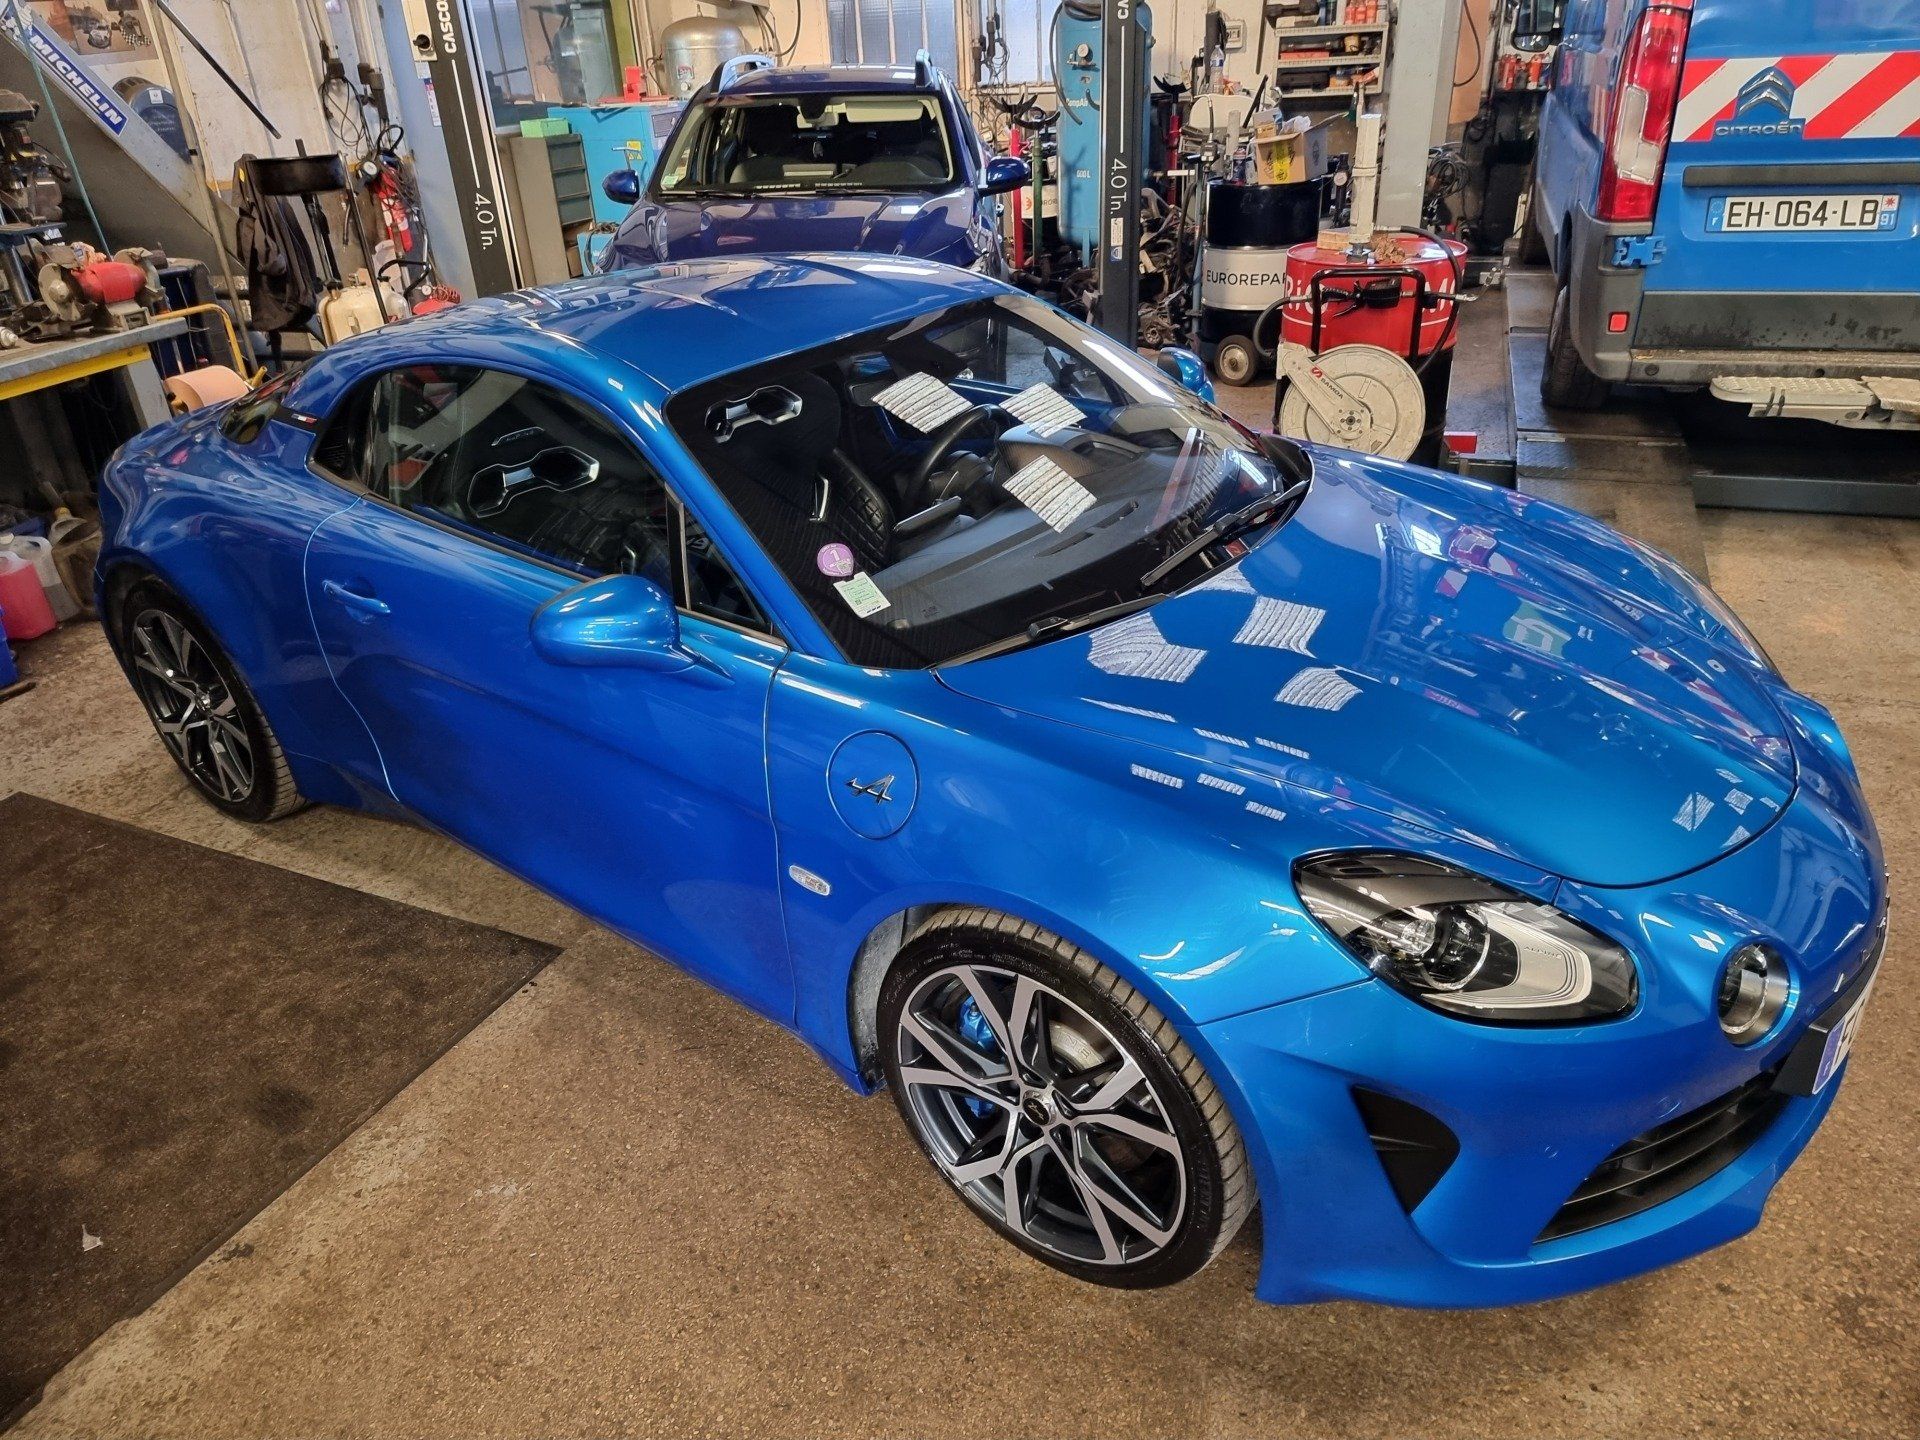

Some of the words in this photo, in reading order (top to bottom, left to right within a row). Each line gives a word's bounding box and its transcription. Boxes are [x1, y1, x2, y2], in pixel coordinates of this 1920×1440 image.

[436, 0, 457, 53] CASCO
[29, 35, 122, 125] MICHELIN
[1110, 158, 1127, 188] 4.0
[475, 192, 494, 224] 4.0
[1727, 200, 1878, 228] EH-064-LB
[1880, 212, 1895, 227] 91
